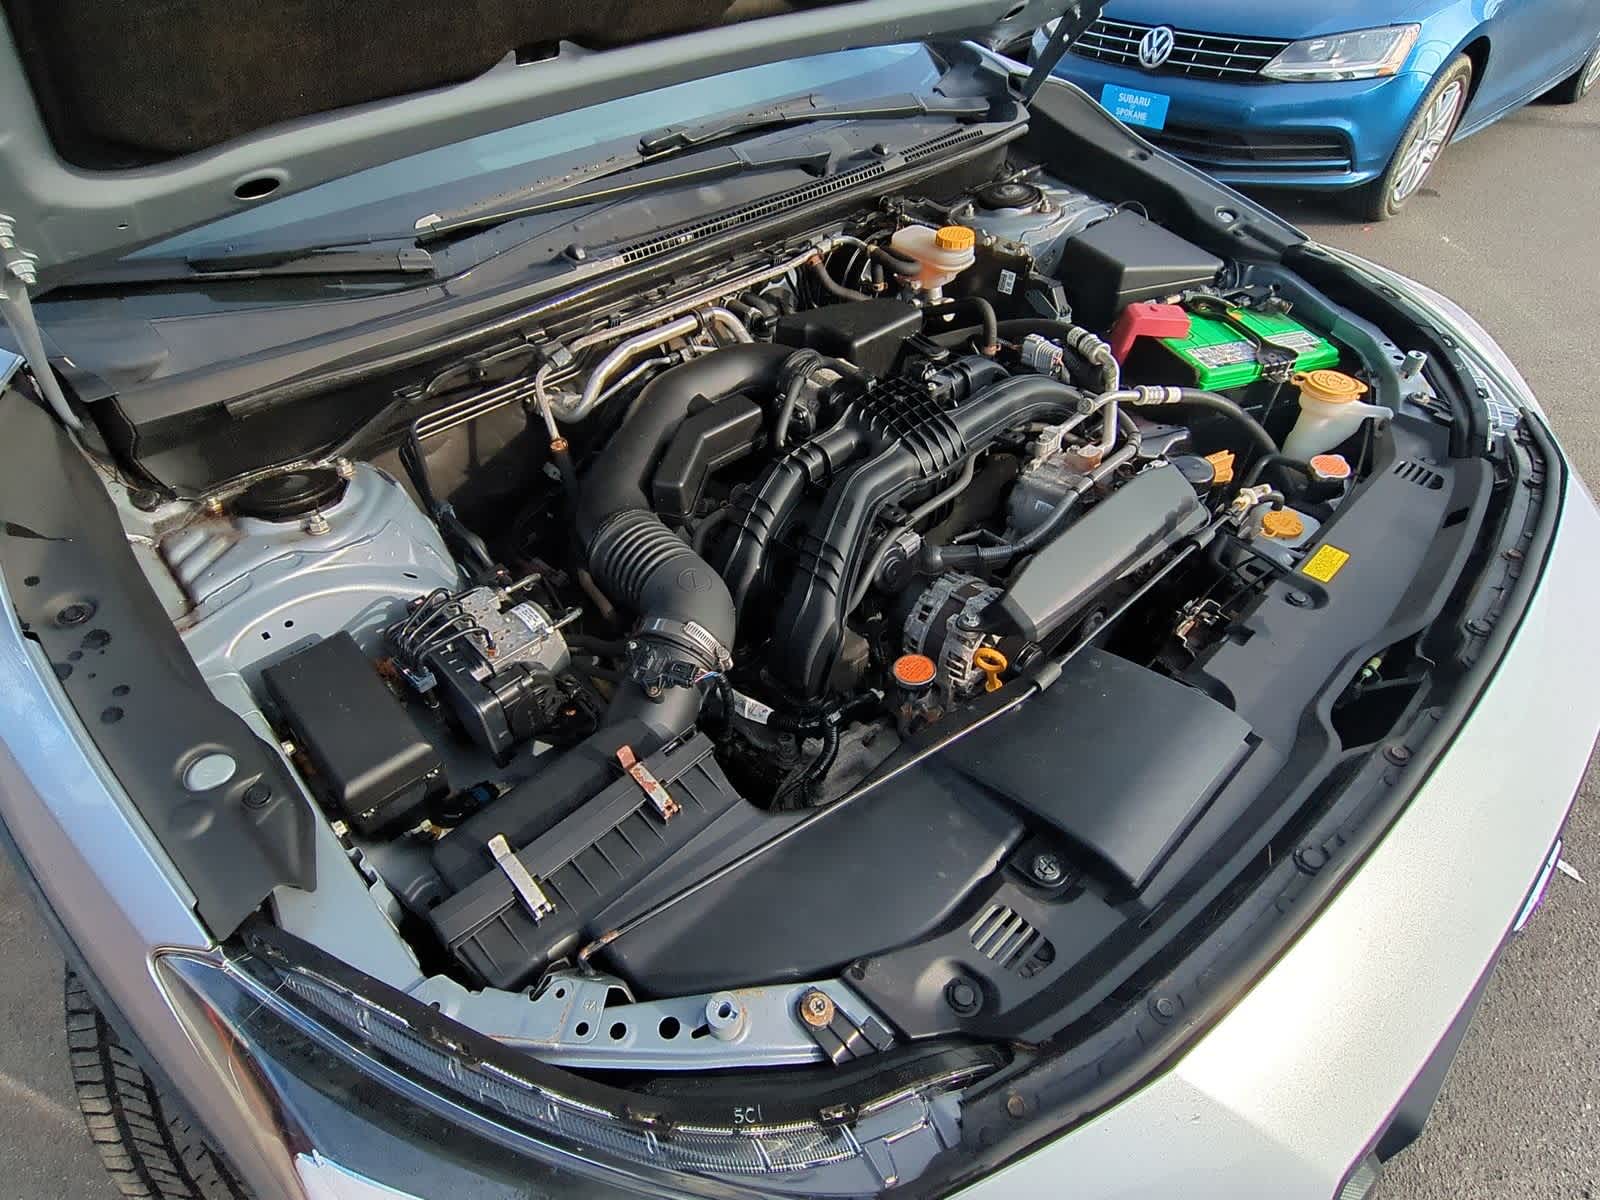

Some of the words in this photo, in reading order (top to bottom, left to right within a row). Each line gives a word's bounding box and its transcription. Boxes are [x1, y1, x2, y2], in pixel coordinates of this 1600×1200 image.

[1140, 27, 1173, 67] VW
[1119, 92, 1151, 106] SUBARU
[1116, 107, 1148, 120] SPOKANE
